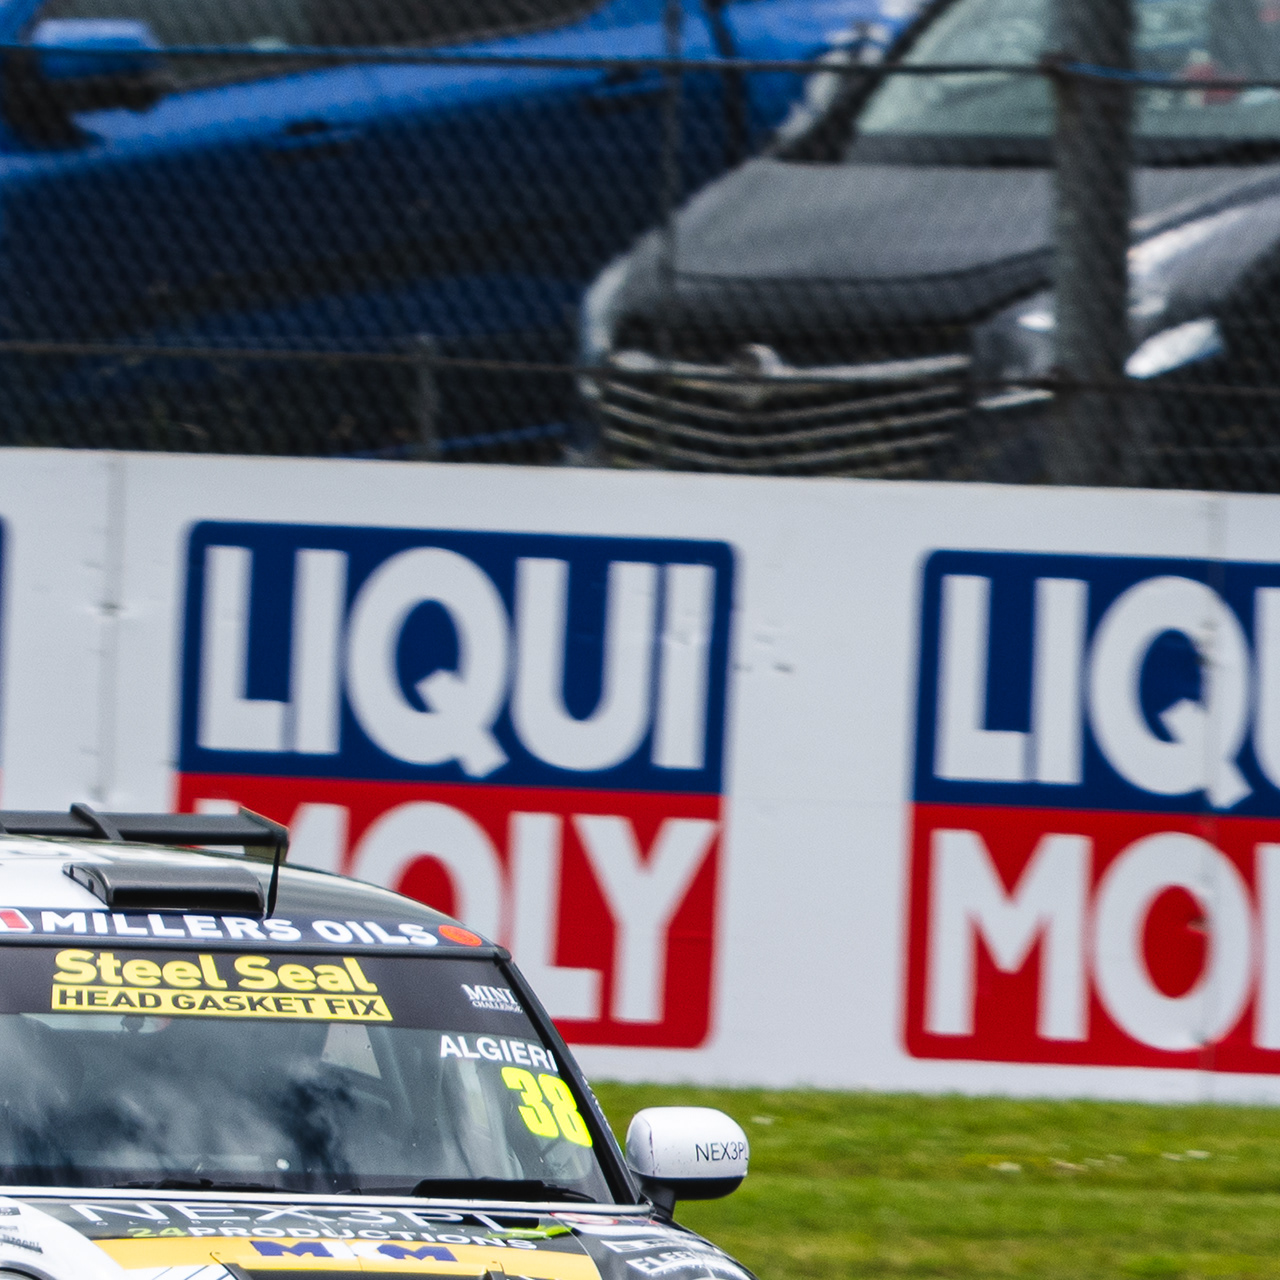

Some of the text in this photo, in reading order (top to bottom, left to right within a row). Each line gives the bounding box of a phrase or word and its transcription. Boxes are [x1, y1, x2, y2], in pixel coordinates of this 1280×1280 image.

[199, 547, 714, 778] LIQUI
[41, 911, 438, 947] MILLERS OILS
[53, 949, 378, 993] Steel Seal
[58, 989, 385, 1016] HEAD GASKET FIX
[461, 984, 517, 1004] MINI
[440, 1034, 558, 1072] ALGIERI
[501, 1067, 593, 1147] 38
[250, 1240, 458, 1262] MKM
